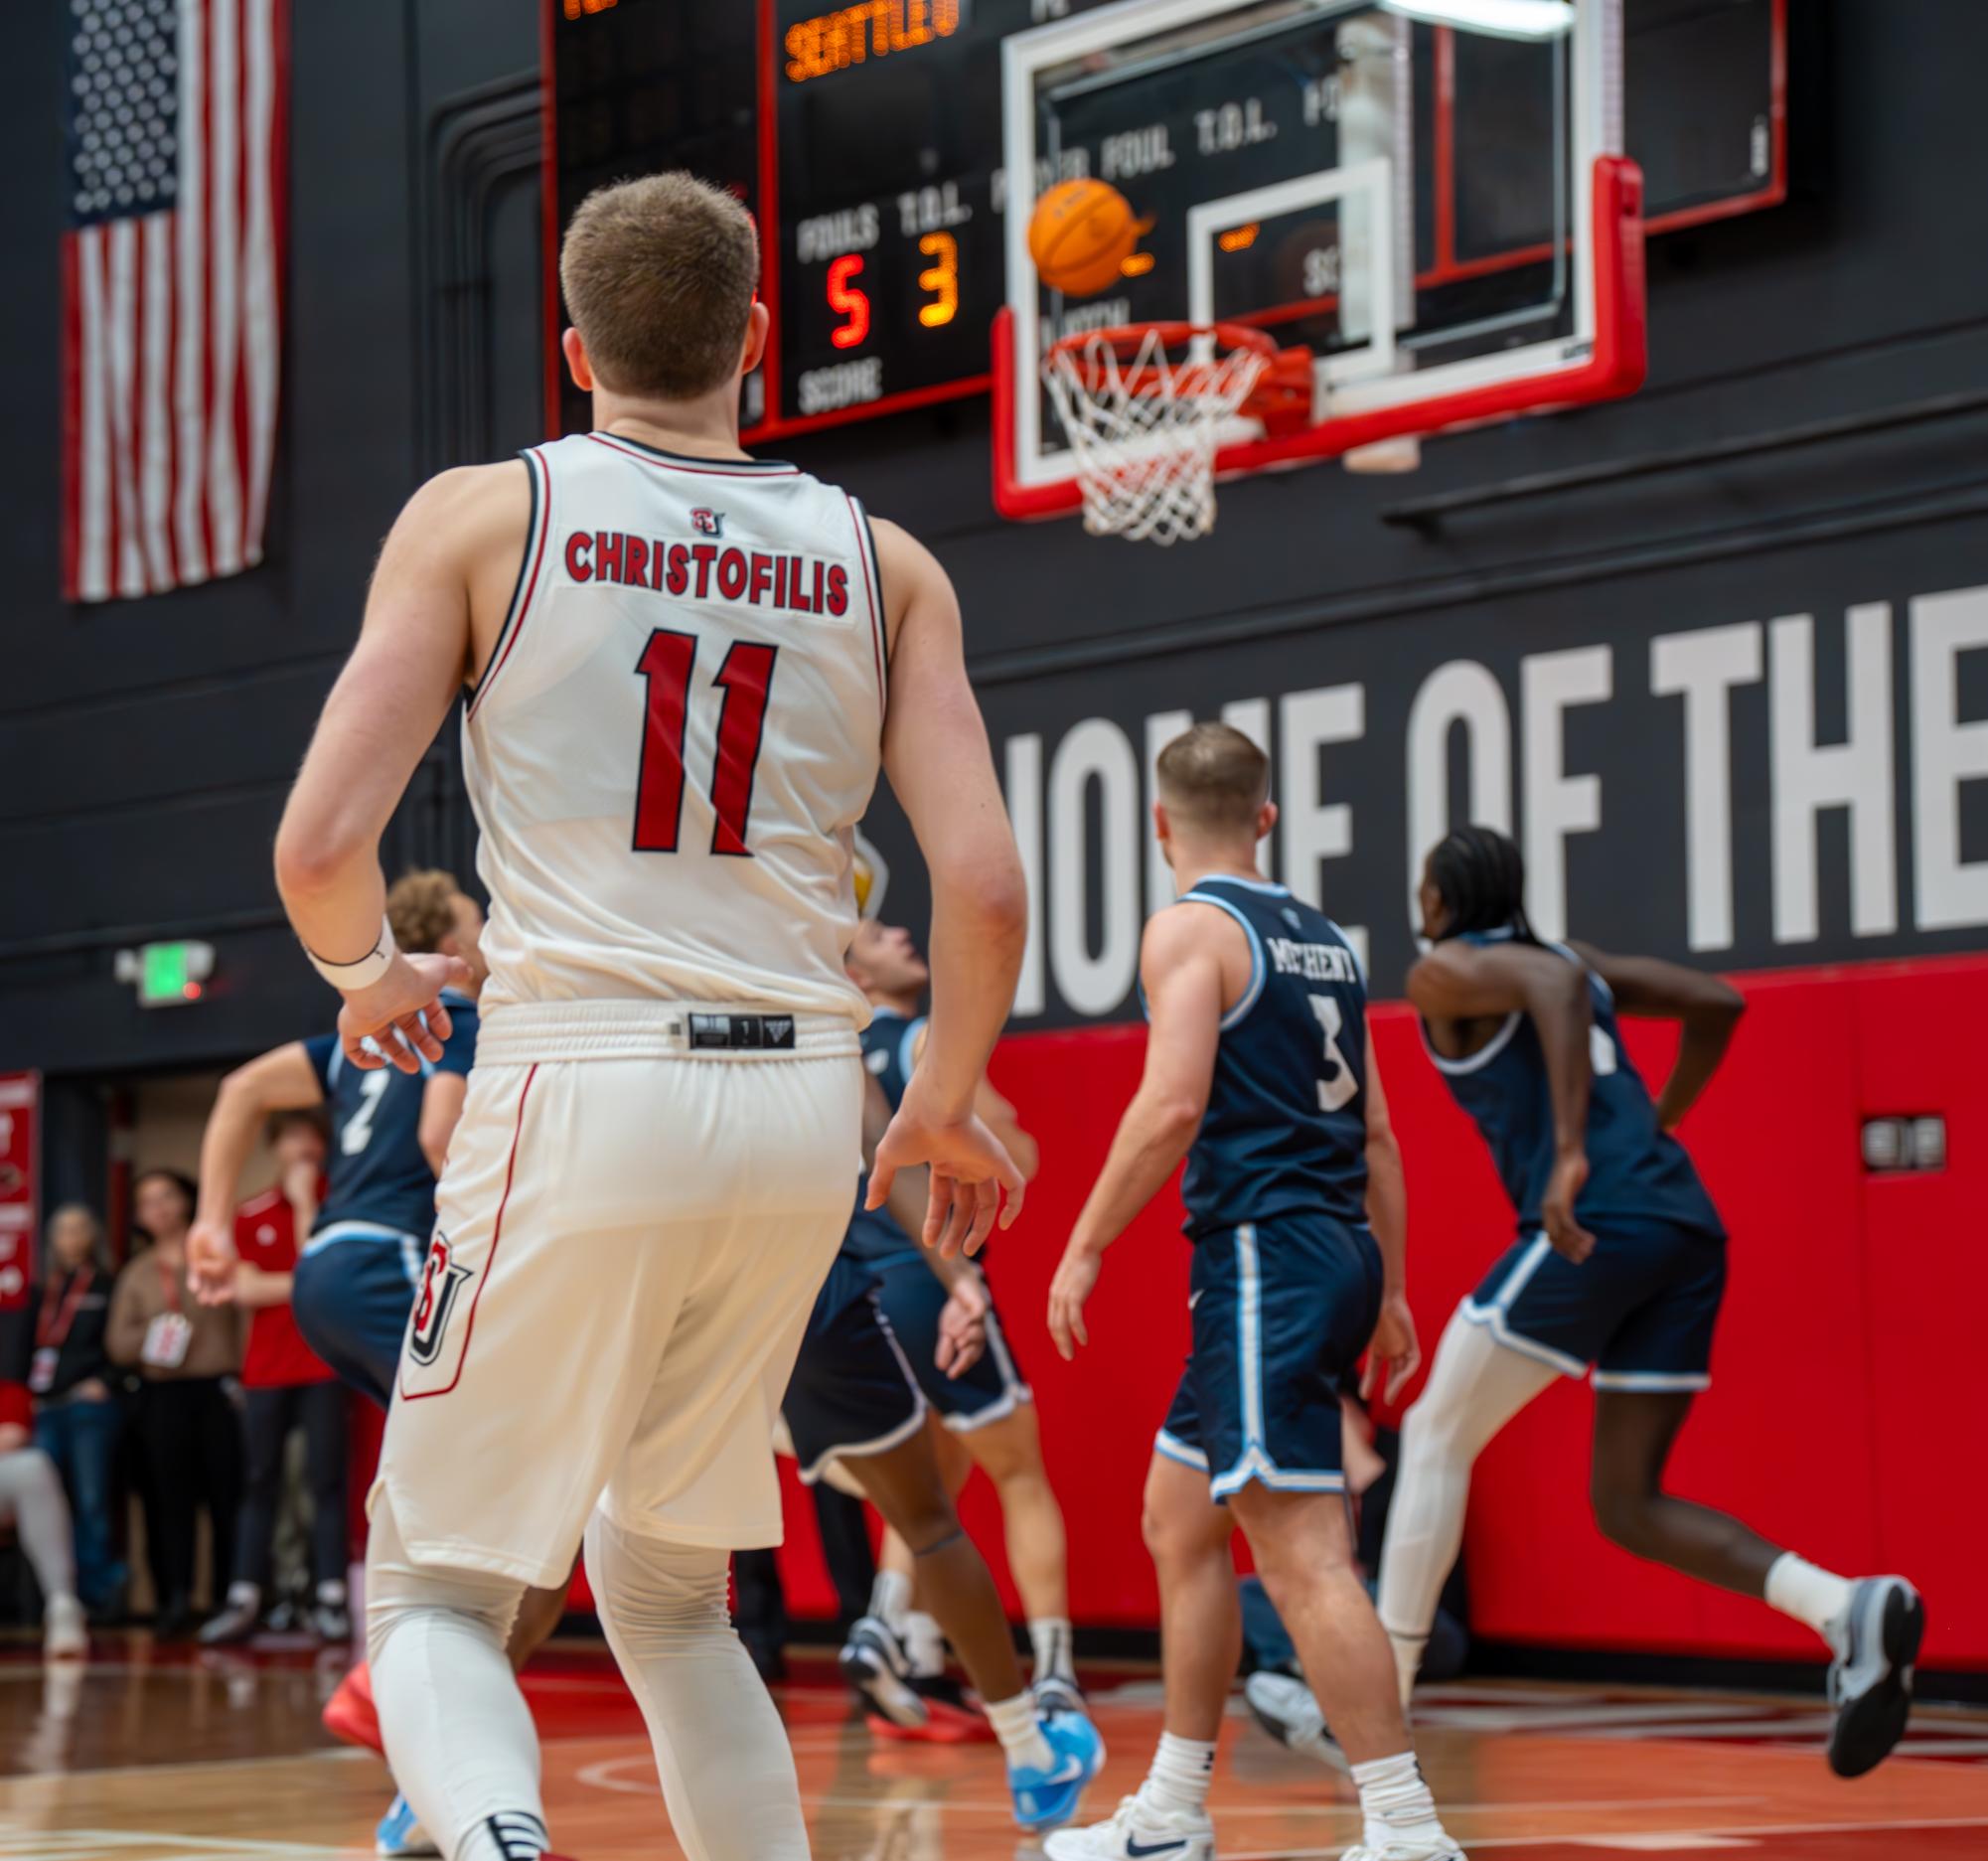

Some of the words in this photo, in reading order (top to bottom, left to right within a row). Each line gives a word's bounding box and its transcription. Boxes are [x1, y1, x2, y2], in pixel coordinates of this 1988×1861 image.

[827, 253, 870, 349] 5
[918, 231, 959, 327] 3
[564, 531, 849, 618] CHRISTOFILIS
[632, 627, 780, 856] 11
[1650, 584, 1988, 952] THE
[1307, 994, 1359, 1113] 3
